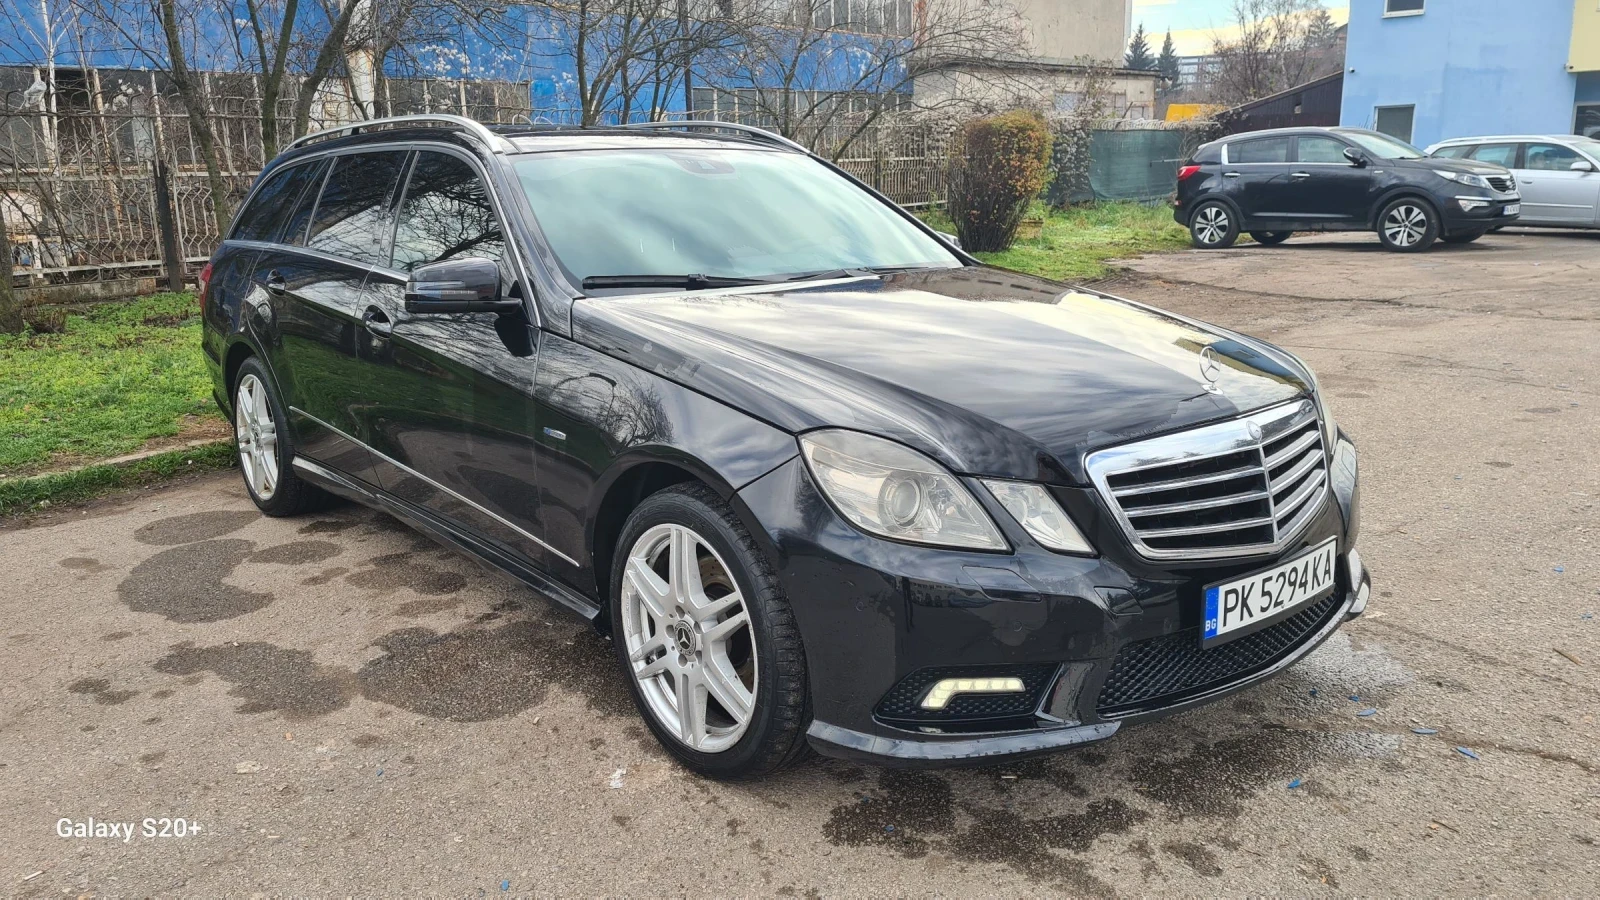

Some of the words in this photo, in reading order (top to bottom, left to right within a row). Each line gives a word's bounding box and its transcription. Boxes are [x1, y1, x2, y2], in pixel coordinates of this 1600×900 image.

[1222, 581, 1255, 627] PK
[1260, 560, 1309, 613] 5294
[1311, 549, 1332, 591] KA
[1205, 618, 1217, 631] BG
